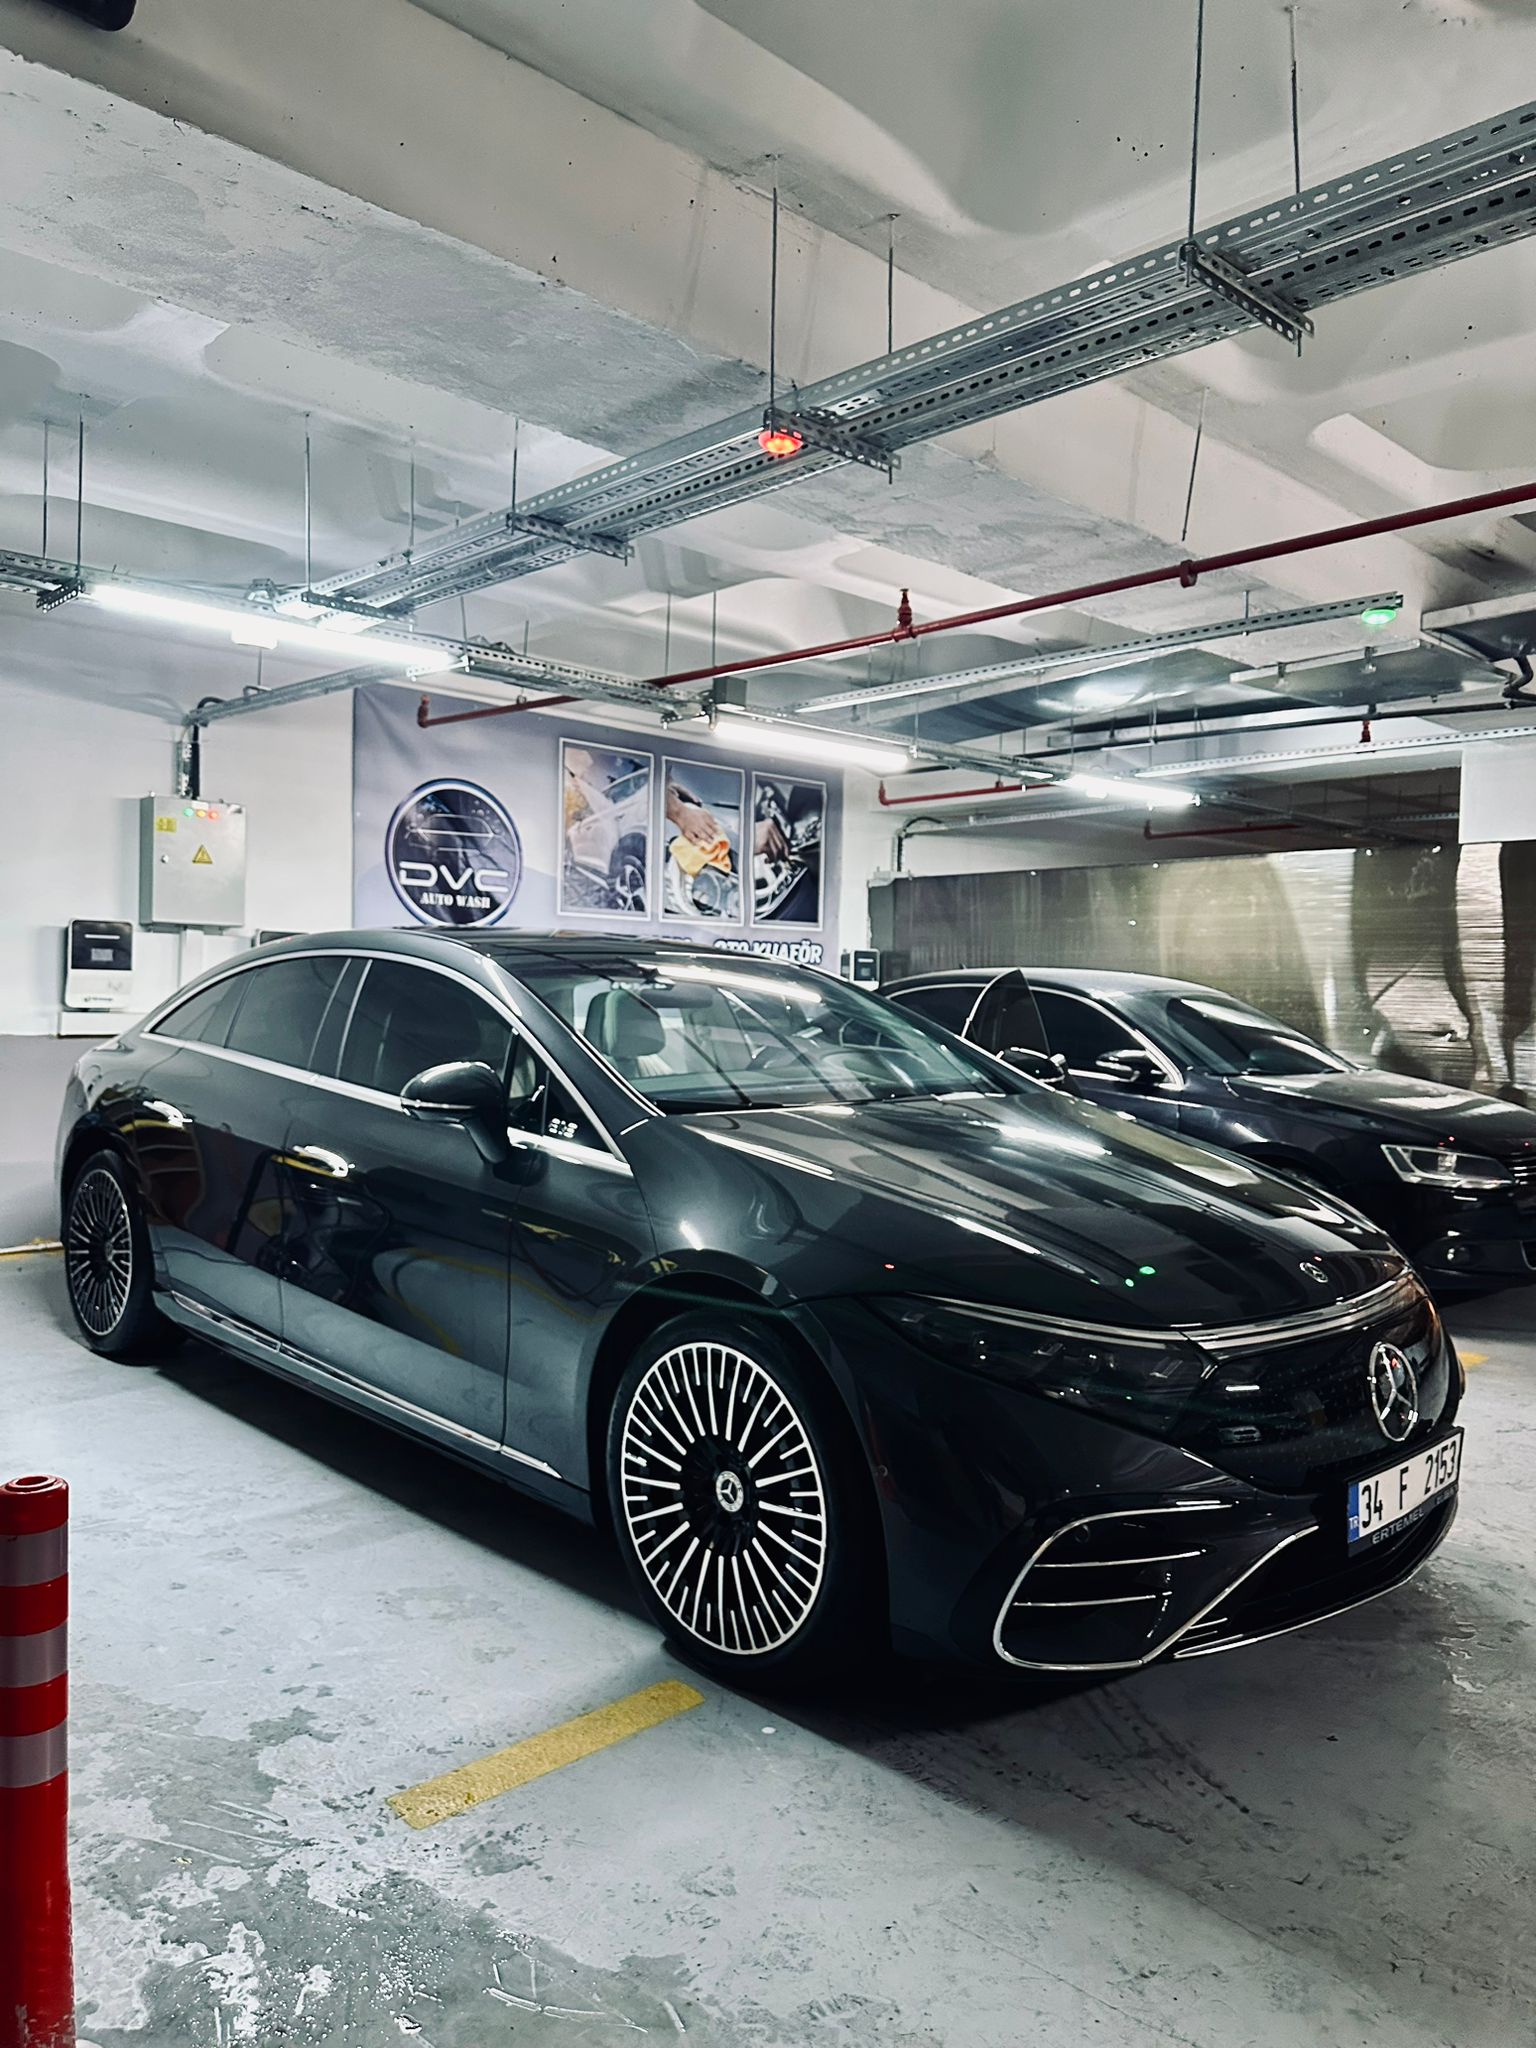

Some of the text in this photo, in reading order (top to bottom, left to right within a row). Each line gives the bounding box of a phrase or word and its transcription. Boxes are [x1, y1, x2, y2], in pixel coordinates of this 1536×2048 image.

[399, 861, 509, 893] DVC
[420, 892, 491, 909] AUTO WASH
[1361, 1480, 1383, 1529] 34
[1399, 1465, 1409, 1511] F
[1424, 1440, 1457, 1496] 2153
[1349, 1516, 1360, 1529] TR
